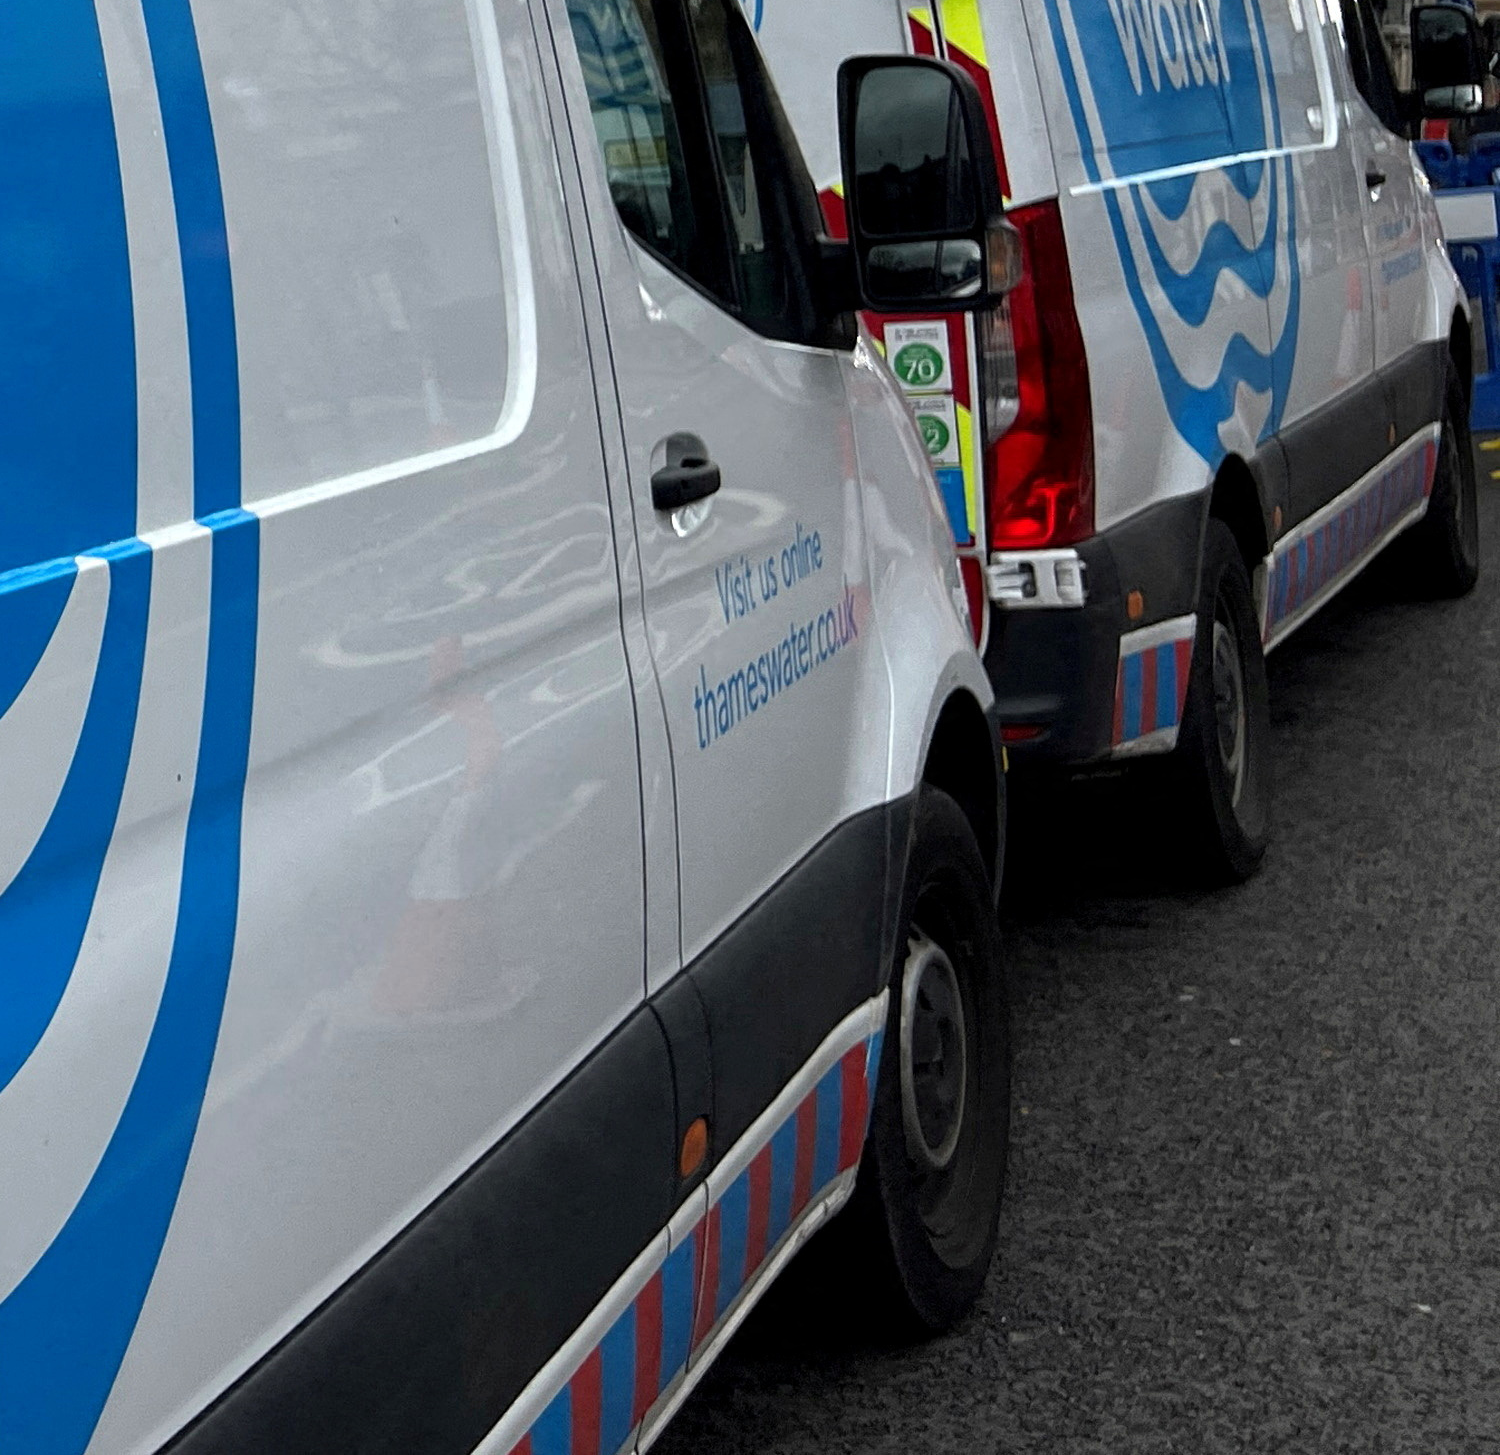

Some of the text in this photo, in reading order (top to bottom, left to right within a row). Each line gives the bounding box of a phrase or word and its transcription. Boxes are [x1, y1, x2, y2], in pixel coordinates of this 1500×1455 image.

[903, 358, 935, 381] 70
[715, 521, 823, 624] Visit us online
[694, 573, 858, 750] thameswater.co.uk
